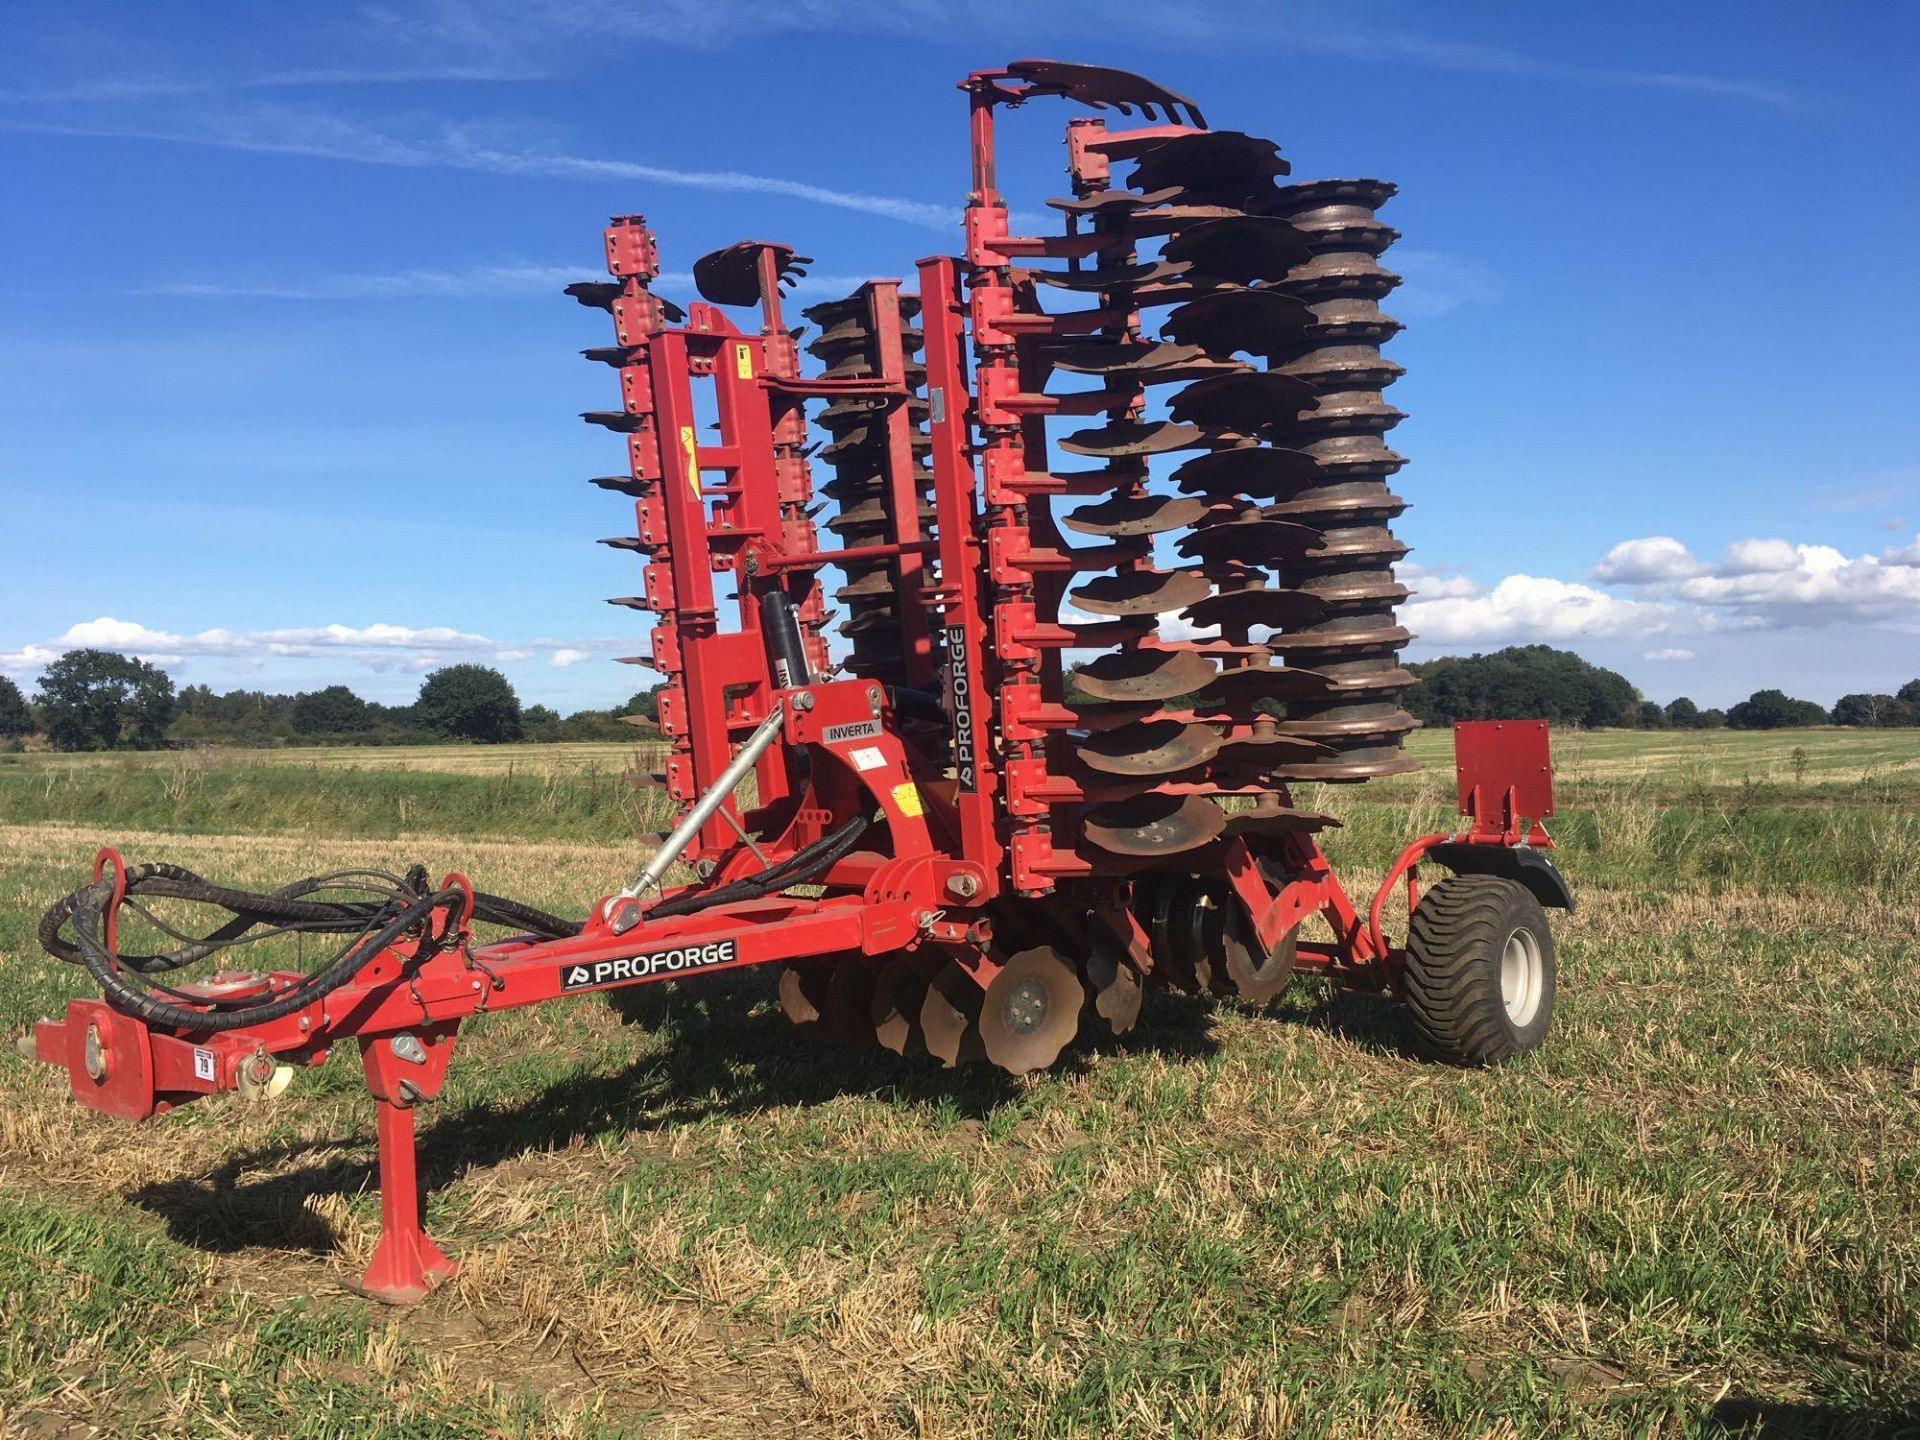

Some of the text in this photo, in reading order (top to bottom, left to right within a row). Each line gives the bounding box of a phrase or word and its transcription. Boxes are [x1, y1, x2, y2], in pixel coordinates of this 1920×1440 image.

[950, 628, 973, 762] PROFORGE
[830, 723, 875, 740] INVERTA
[595, 942, 733, 983] PROFORGE
